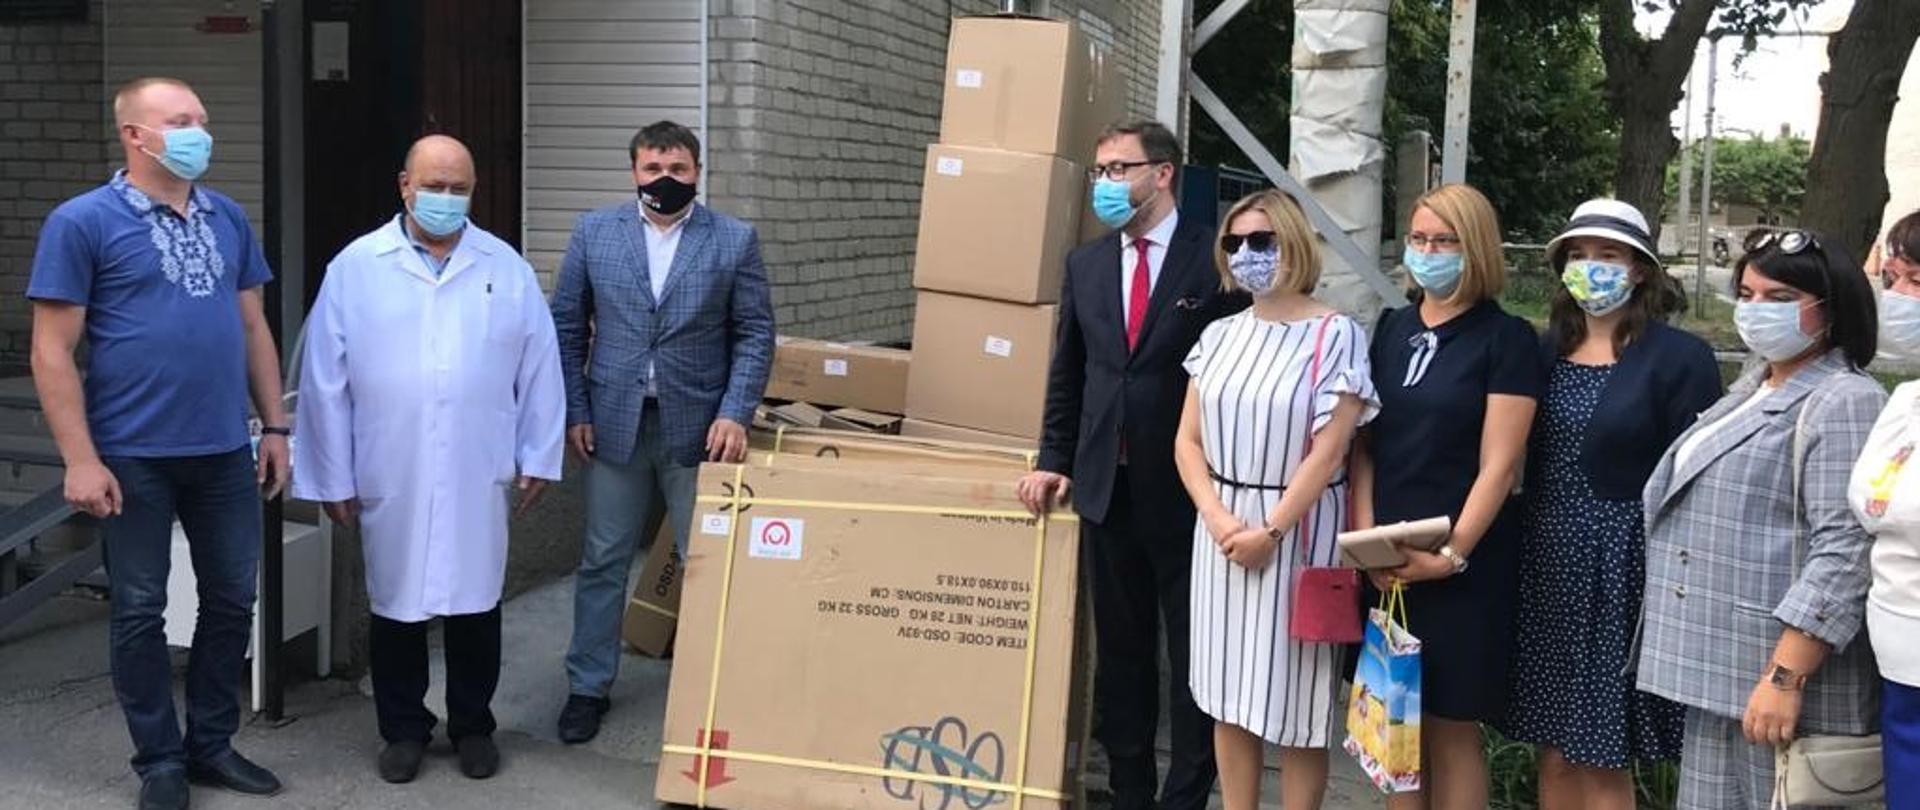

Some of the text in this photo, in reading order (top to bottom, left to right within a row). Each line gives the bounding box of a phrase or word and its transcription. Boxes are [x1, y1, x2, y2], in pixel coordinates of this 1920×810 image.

[870, 586, 1030, 612] CARTON DIMENSIONS: CM
[818, 600, 836, 613] KG
[856, 605, 900, 619] GROSS
[910, 608, 928, 620] KG
[949, 613, 972, 625] NET
[997, 638, 1028, 649] ITEM
[883, 716, 1005, 810] OSD
